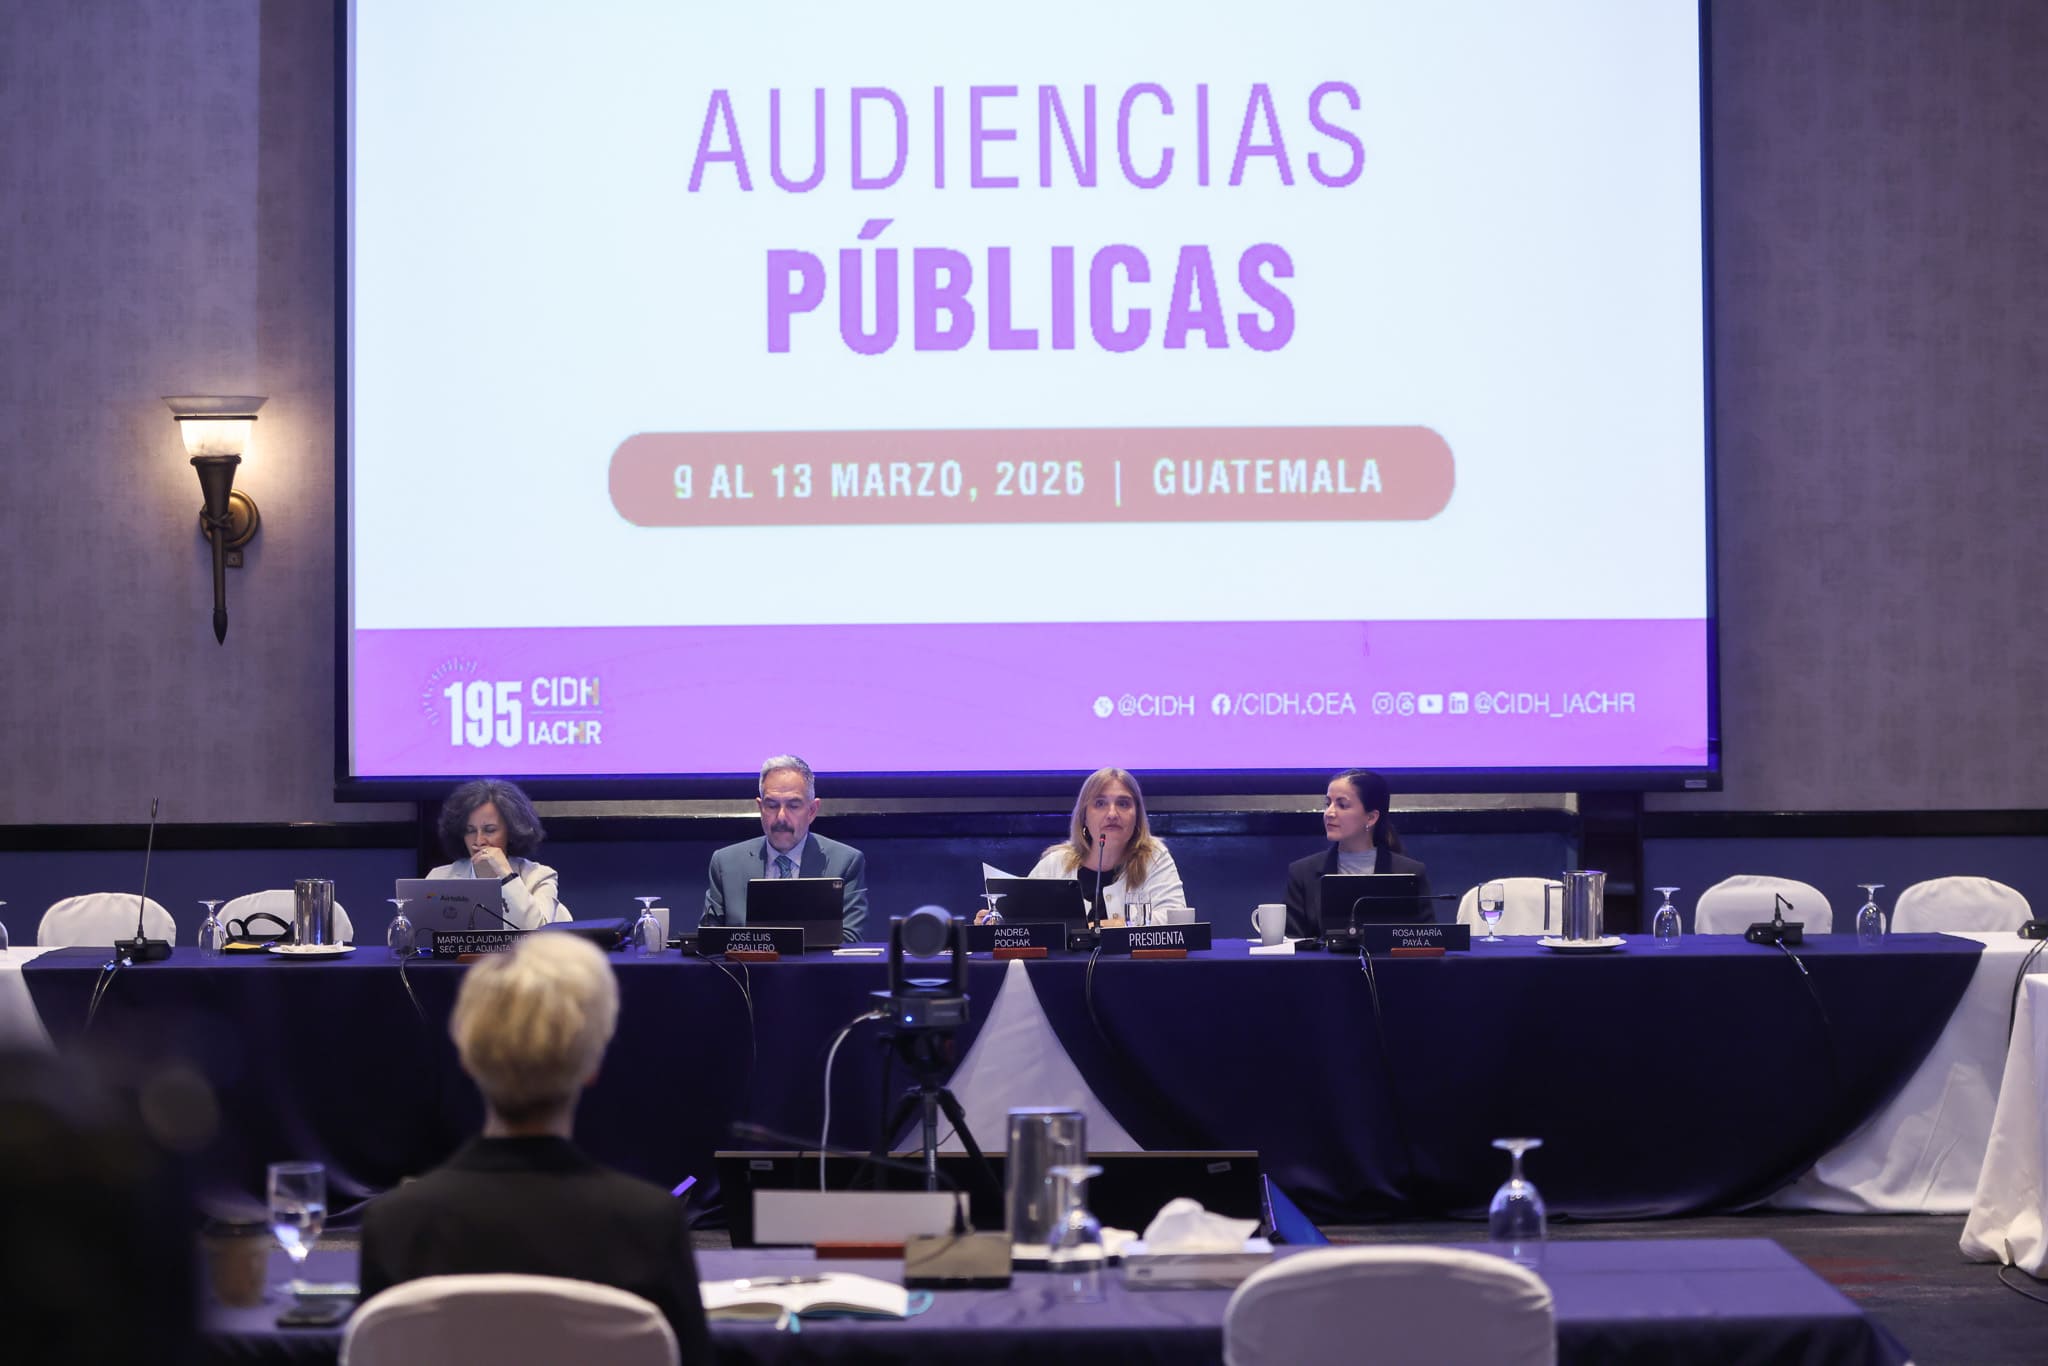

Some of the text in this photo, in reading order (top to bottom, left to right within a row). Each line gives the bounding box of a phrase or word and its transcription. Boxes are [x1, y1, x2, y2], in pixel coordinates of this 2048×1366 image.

[688, 81, 1365, 193] AUDIENCIAS
[767, 218, 1295, 355] PÚBLICAS
[674, 464, 693, 499] 9
[709, 464, 753, 499] AL
[772, 463, 812, 498] 13
[831, 460, 977, 502] MARZO,
[996, 460, 1085, 496] 2026
[1153, 458, 1382, 496] GUATEMALA
[531, 677, 600, 706] CIDH
[1117, 694, 1195, 717] @CIDH
[1232, 692, 1356, 716] /CIDH.OEA
[1474, 691, 1635, 718] @CIDH_IACHR
[444, 680, 522, 747] 195
[528, 720, 602, 745] IACHR
[466, 935, 503, 944] CLAUDIA
[730, 932, 771, 942] JOSÉ LUIS
[994, 928, 1030, 937] ANDREA
[1129, 930, 1185, 947] PRESIDENTA
[1392, 929, 1415, 937] ROSA
[439, 945, 457, 954] SEC.
[475, 943, 512, 953] ADJUNTA
[726, 943, 775, 952] CABALLERO
[994, 938, 1031, 947] POCHAK
[1402, 938, 1422, 947] PAYÁ
